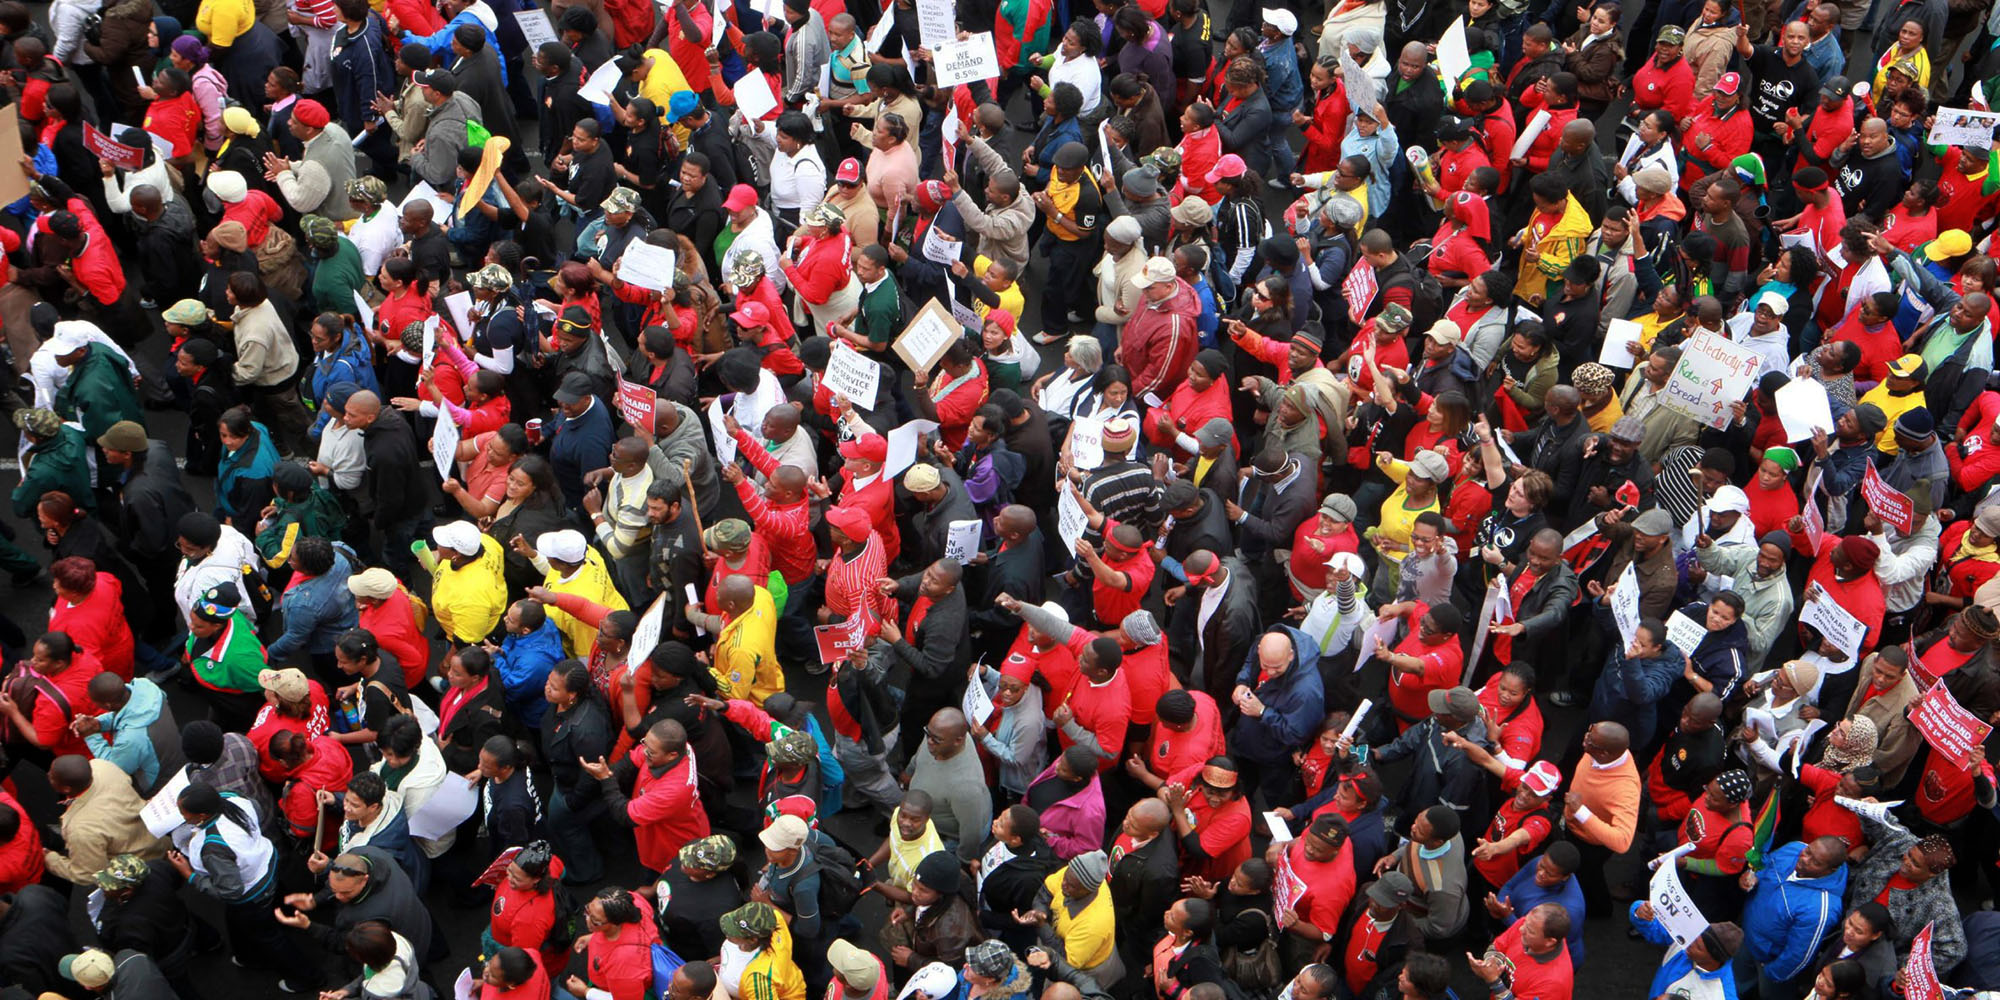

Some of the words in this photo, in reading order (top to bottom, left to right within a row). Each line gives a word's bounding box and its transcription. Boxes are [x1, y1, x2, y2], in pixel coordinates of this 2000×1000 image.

[946, 56, 983, 71] DEMAND
[956, 51, 970, 59] WE
[955, 70, 979, 79] 8.5%
[1760, 79, 1776, 95] PSA
[832, 363, 840, 374] NO
[840, 370, 870, 390] SERVICE
[838, 359, 874, 382] SETTLEMENT
[832, 375, 864, 397] DELIVERY
[1669, 380, 1703, 405] Bread
[1085, 436, 1097, 445] TO
[1883, 503, 1908, 520] TERM
[1814, 613, 1849, 648] OWNERSHIP
[1921, 701, 1973, 752] IMPLEMENTATION
[1930, 696, 1941, 713] WE
[1941, 710, 1972, 740] DEMAND
[1919, 712, 1934, 730] DATE
[1940, 737, 1963, 757] APRIL
[1666, 873, 1681, 903] 6.5%
[1659, 893, 1680, 917] NO
[1683, 905, 1693, 919] TO
[1914, 964, 1928, 1000] MEDICAL
[1918, 956, 1931, 992] DEMAND
